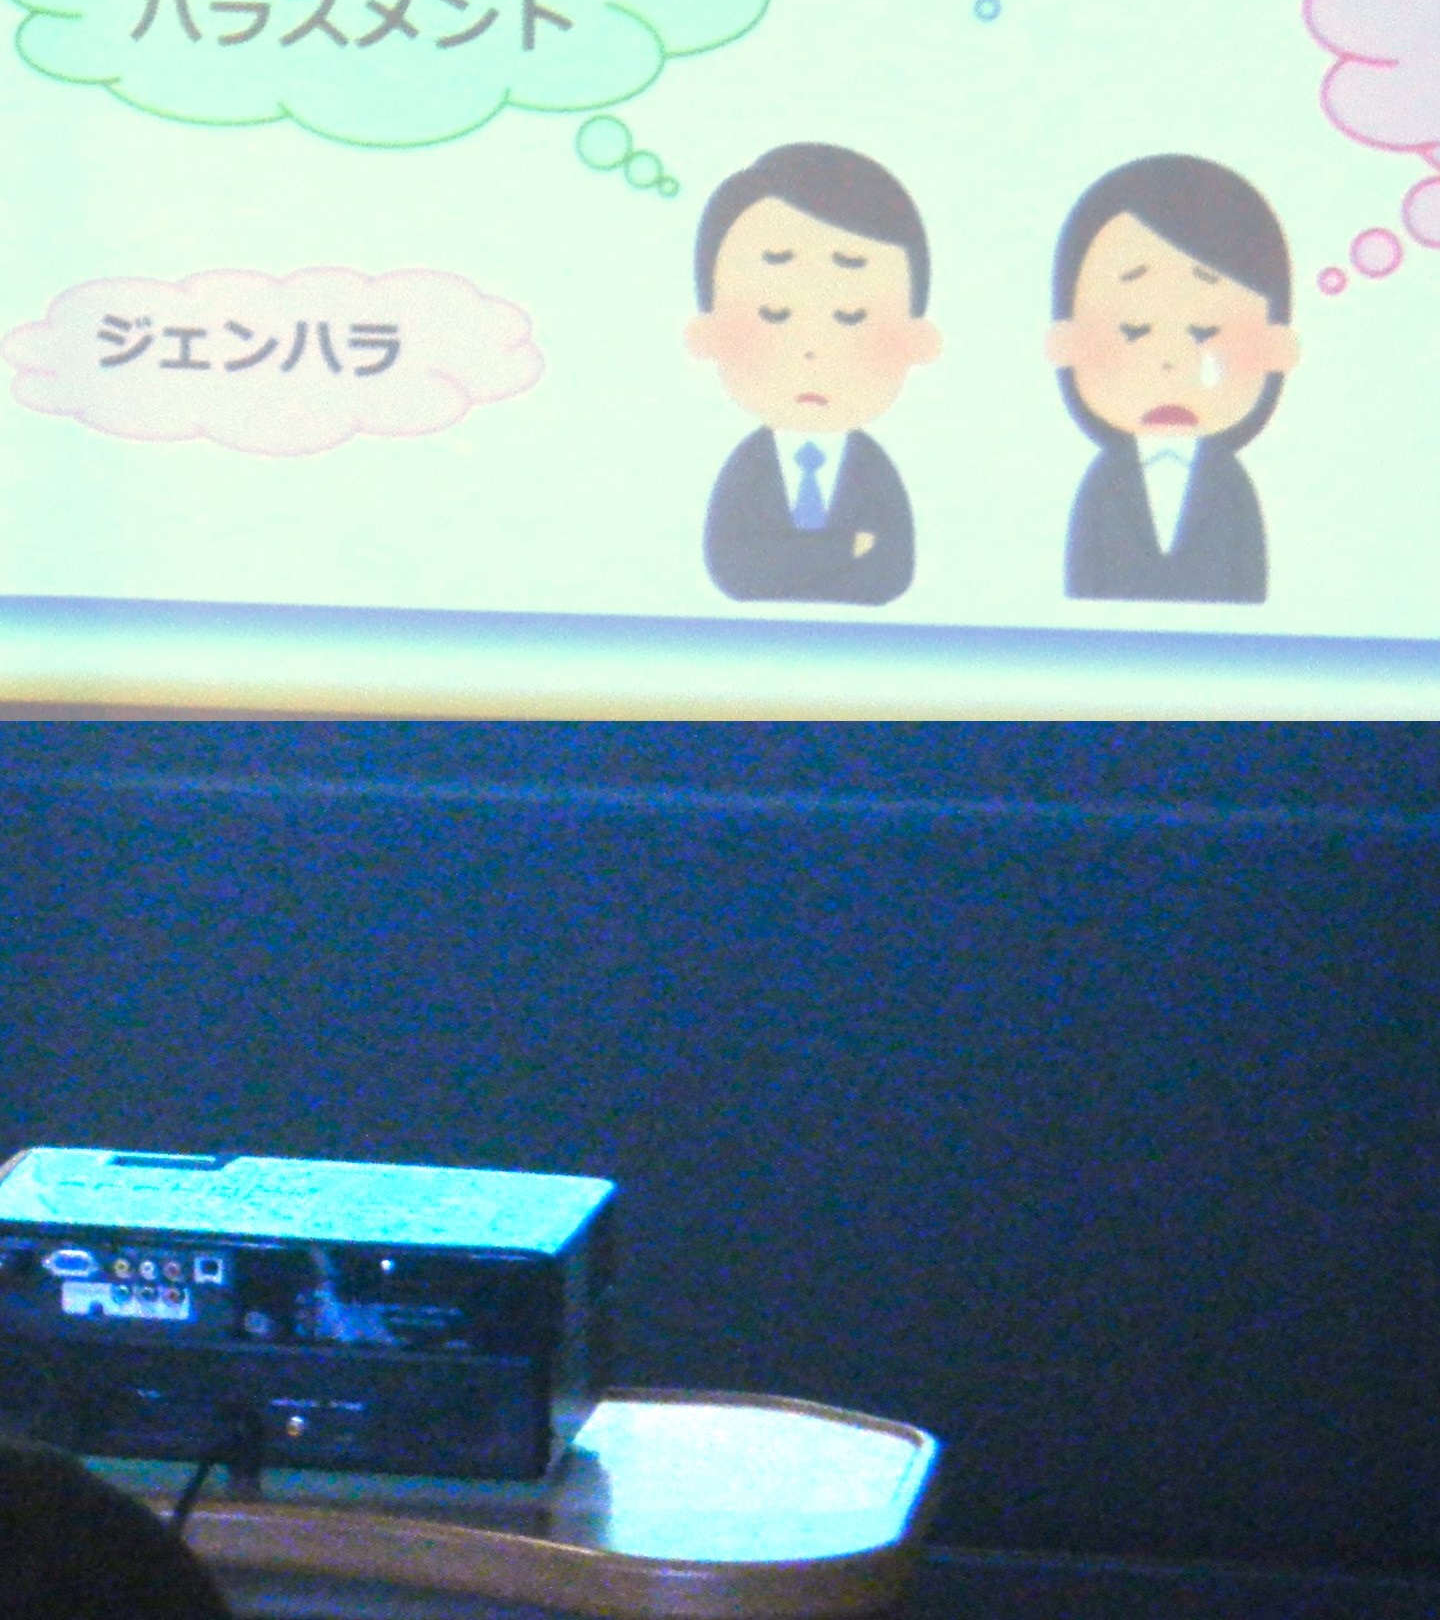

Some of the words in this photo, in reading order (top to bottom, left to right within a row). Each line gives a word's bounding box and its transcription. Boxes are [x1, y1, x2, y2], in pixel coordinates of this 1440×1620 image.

[96, 314, 404, 380] ジェンハラ
